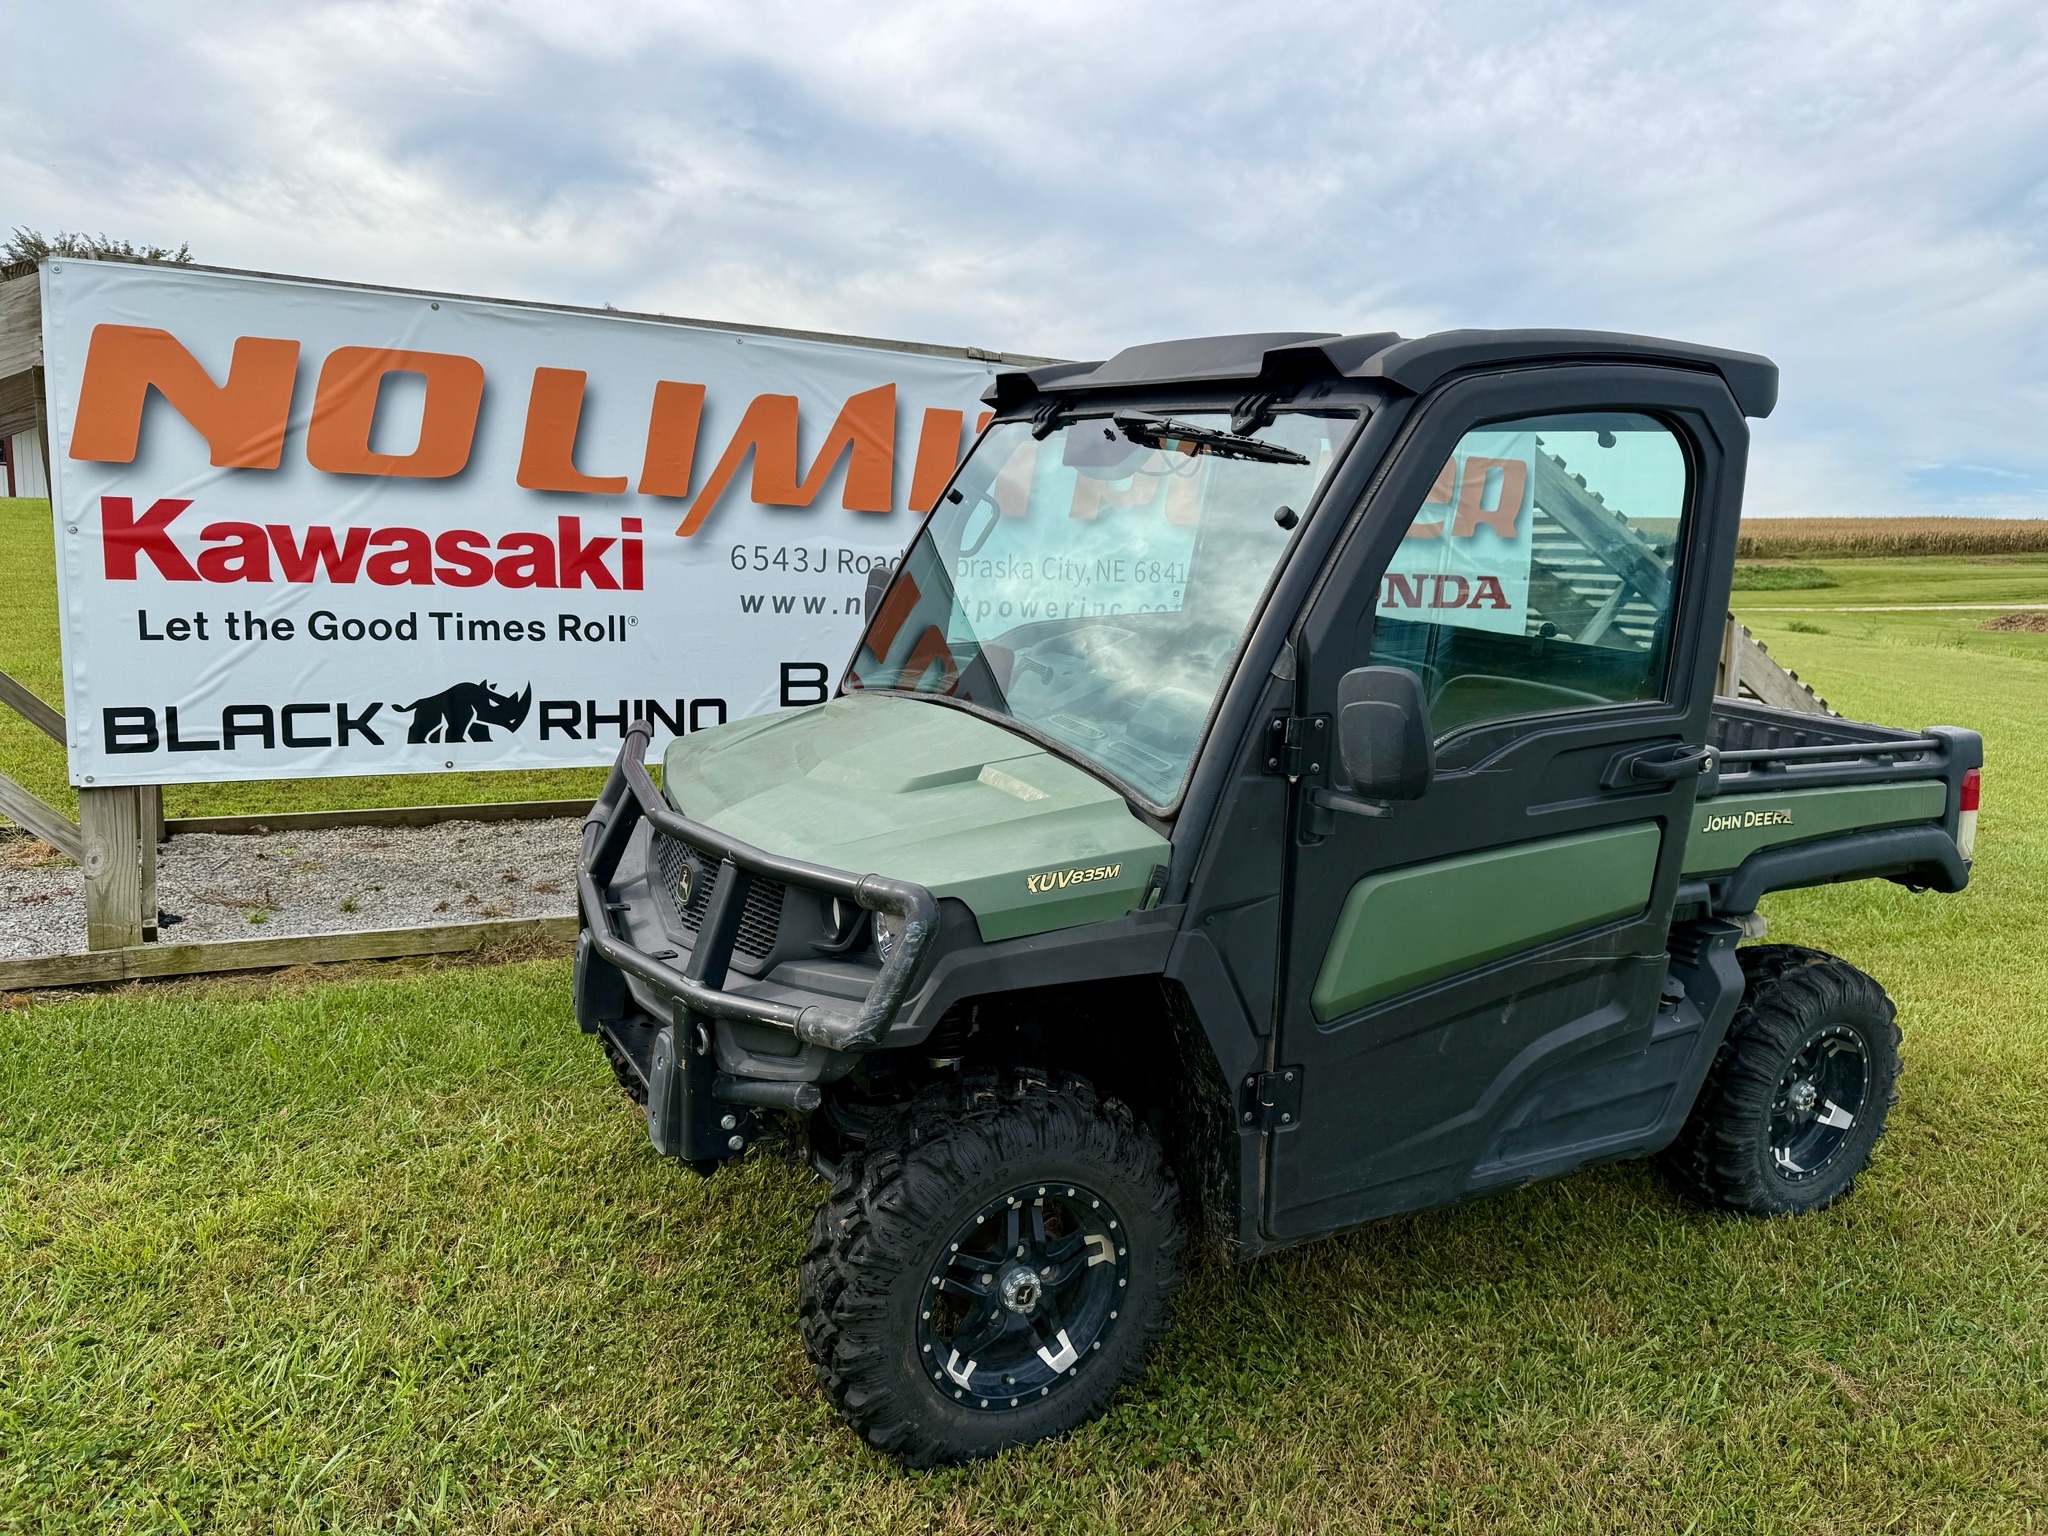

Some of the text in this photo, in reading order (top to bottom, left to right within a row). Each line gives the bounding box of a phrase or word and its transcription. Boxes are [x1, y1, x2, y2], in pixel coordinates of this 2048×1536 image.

[69, 323, 484, 478] NO
[101, 496, 643, 590] Kawasaki
[1134, 561, 1187, 584] 6841
[1377, 572, 1512, 610] NDA
[138, 609, 209, 642] Let
[225, 610, 295, 641] the
[307, 610, 418, 642] Good
[428, 611, 546, 642] Times
[102, 698, 727, 755] BLACK RHINO
[1702, 814, 1742, 833] JOHN
[1026, 864, 1121, 893] XUV835M
